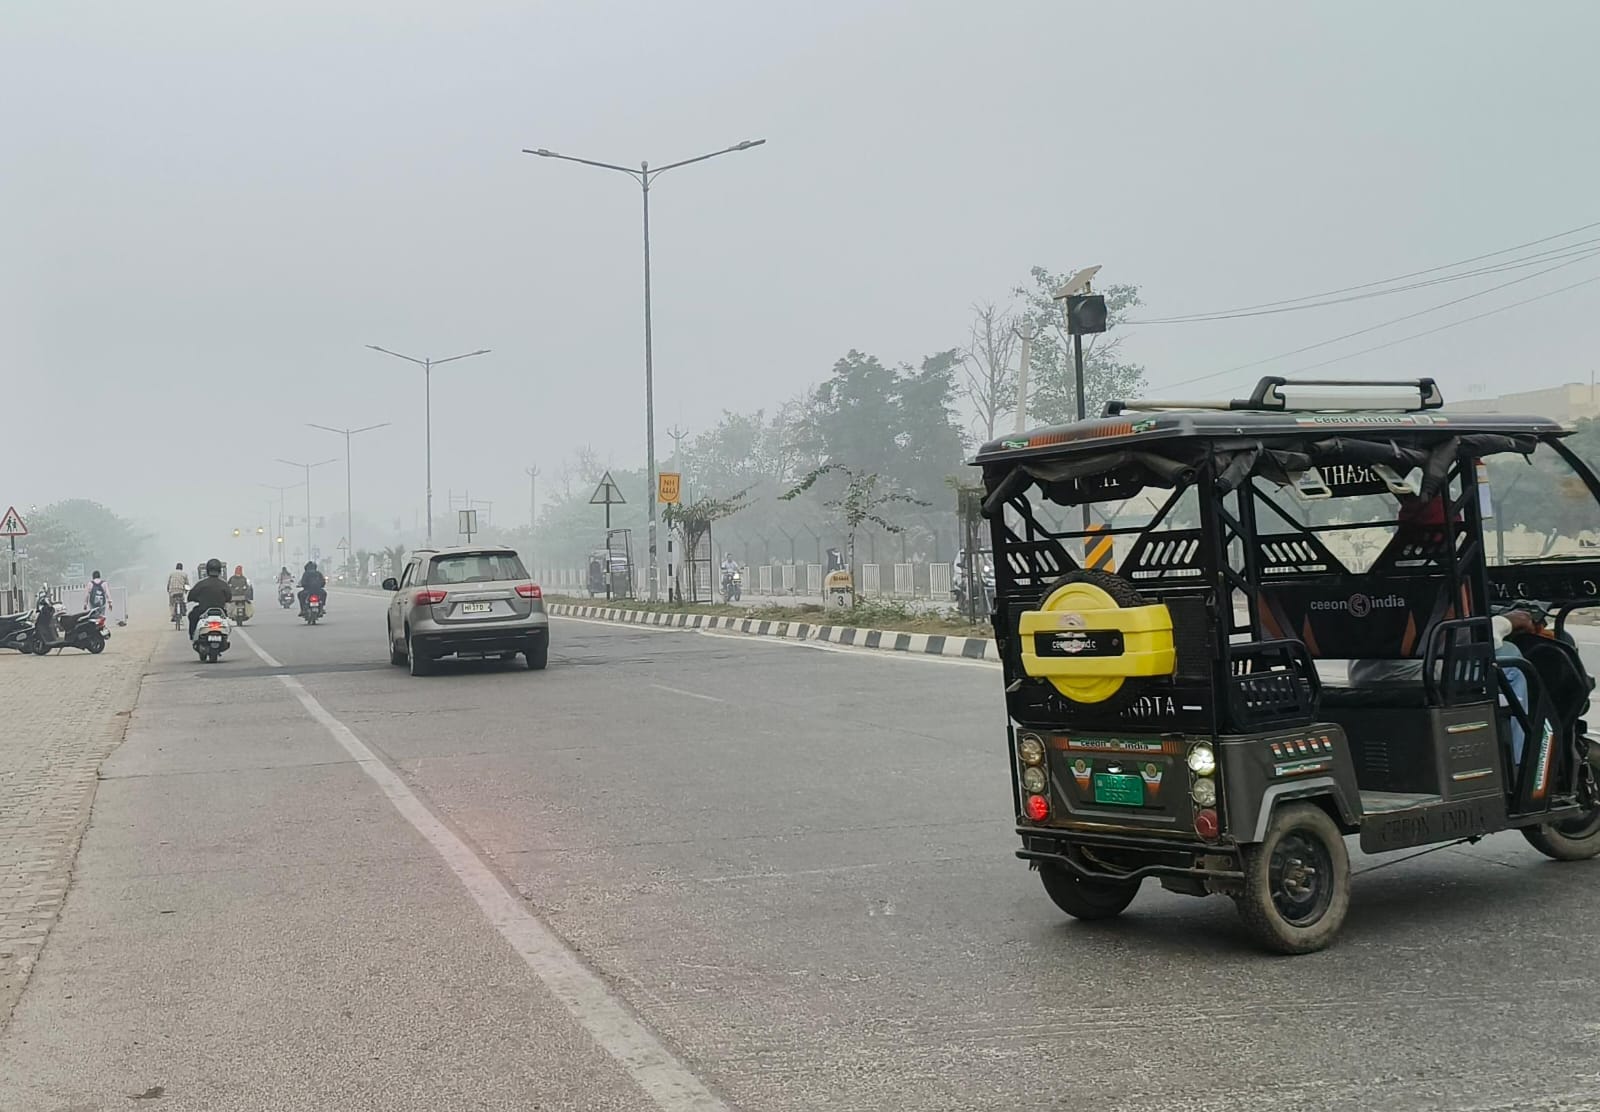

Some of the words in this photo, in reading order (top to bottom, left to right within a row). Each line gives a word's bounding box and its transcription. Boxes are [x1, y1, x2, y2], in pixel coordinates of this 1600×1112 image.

[837, 595, 844, 607] 3
[1310, 600, 1348, 610] ceeon
[1370, 594, 1405, 609] india
